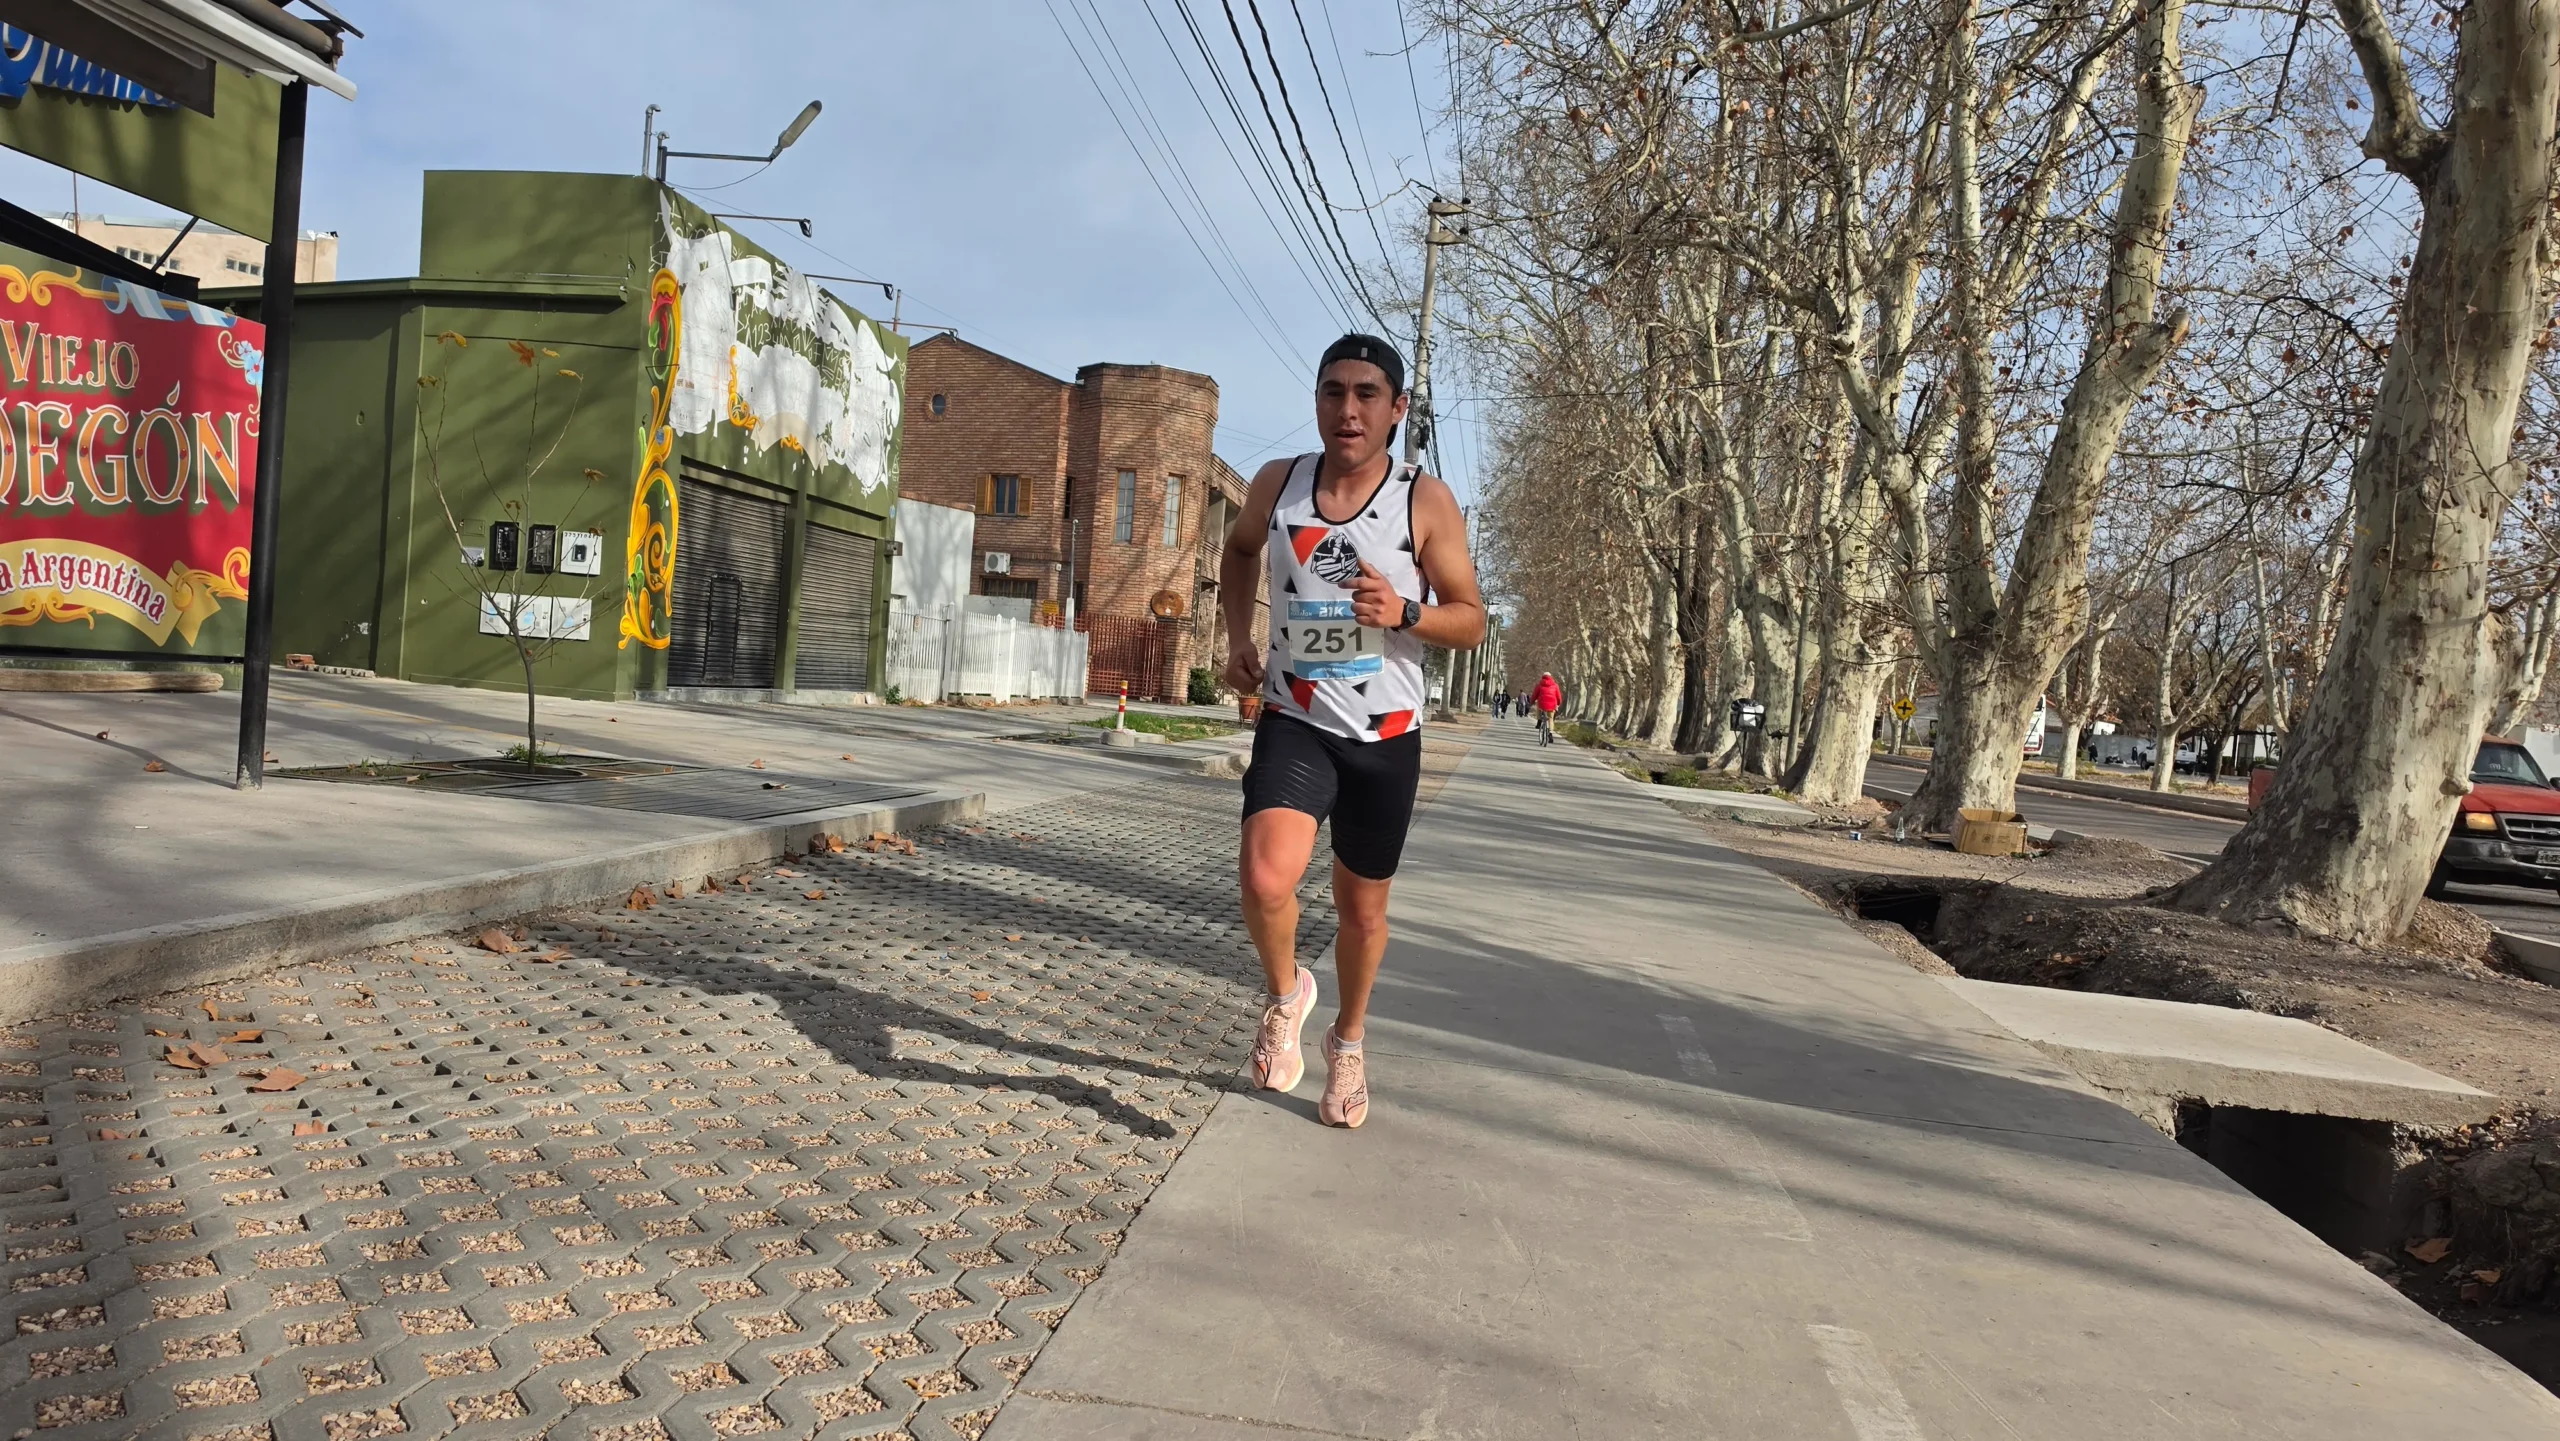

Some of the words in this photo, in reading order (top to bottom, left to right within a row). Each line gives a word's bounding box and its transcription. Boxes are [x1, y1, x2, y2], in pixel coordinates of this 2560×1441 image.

[0, 318, 140, 390] VIEJO
[20, 548, 168, 625] Argentina
[1318, 606, 1346, 618] 21K
[1302, 626, 1363, 654] 251
